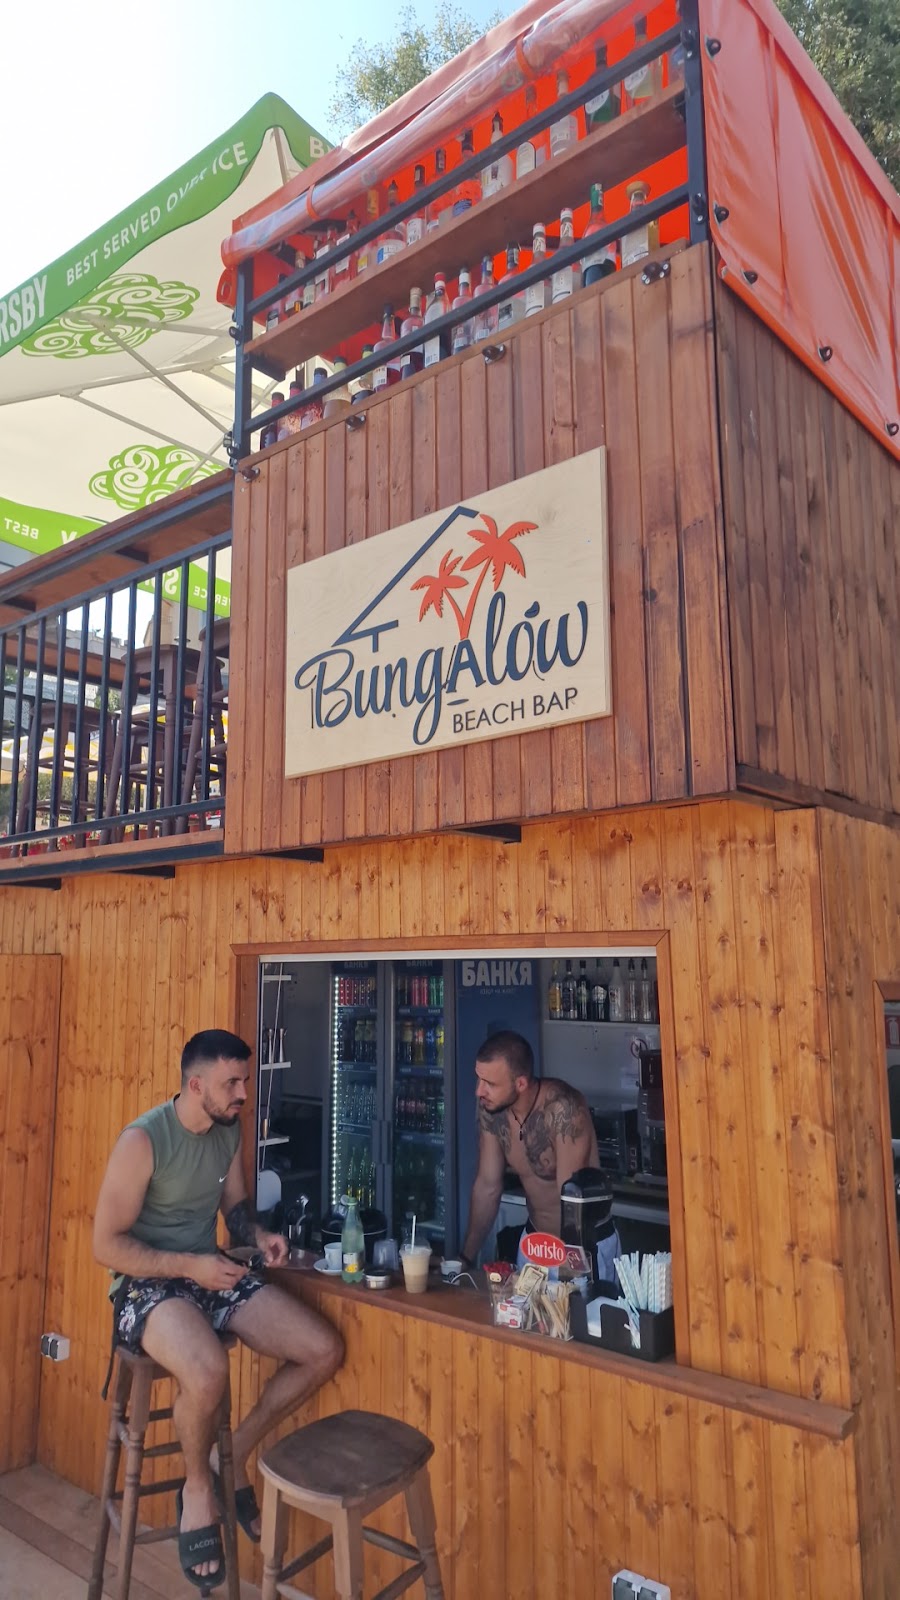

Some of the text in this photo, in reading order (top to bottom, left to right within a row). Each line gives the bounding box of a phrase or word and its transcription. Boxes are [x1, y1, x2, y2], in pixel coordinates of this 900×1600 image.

[67, 250, 98, 286] BEST
[104, 206, 160, 260] SERVED
[212, 141, 248, 175] ICE
[453, 698, 525, 733] BEACH
[462, 960, 532, 987] БАНКЯ
[527, 1238, 564, 1261] baristo
